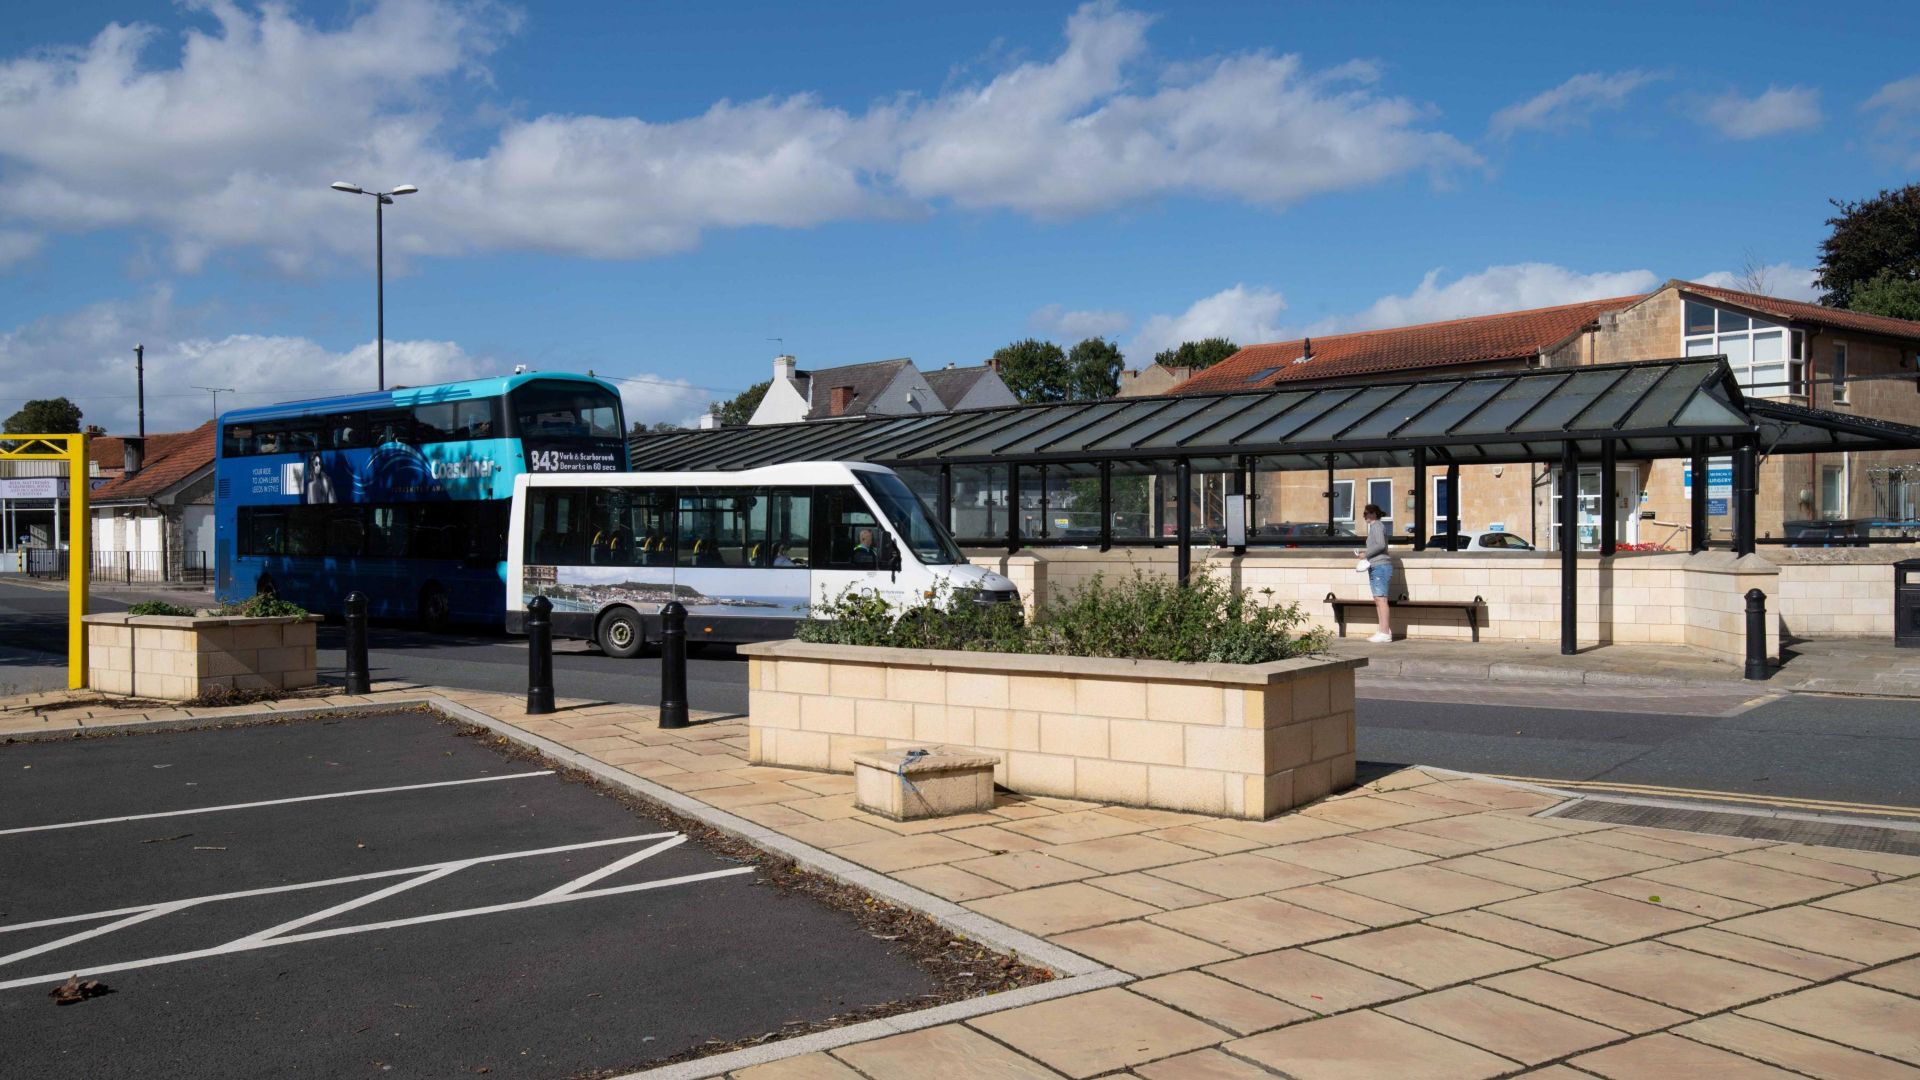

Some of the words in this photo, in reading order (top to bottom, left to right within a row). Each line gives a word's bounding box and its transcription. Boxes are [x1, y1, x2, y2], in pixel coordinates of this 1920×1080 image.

[531, 450, 559, 471] 843
[560, 452, 573, 460] York
[580, 452, 614, 461] Scarborough
[431, 456, 495, 479] Coastliner
[268, 485, 279, 493] STYLE
